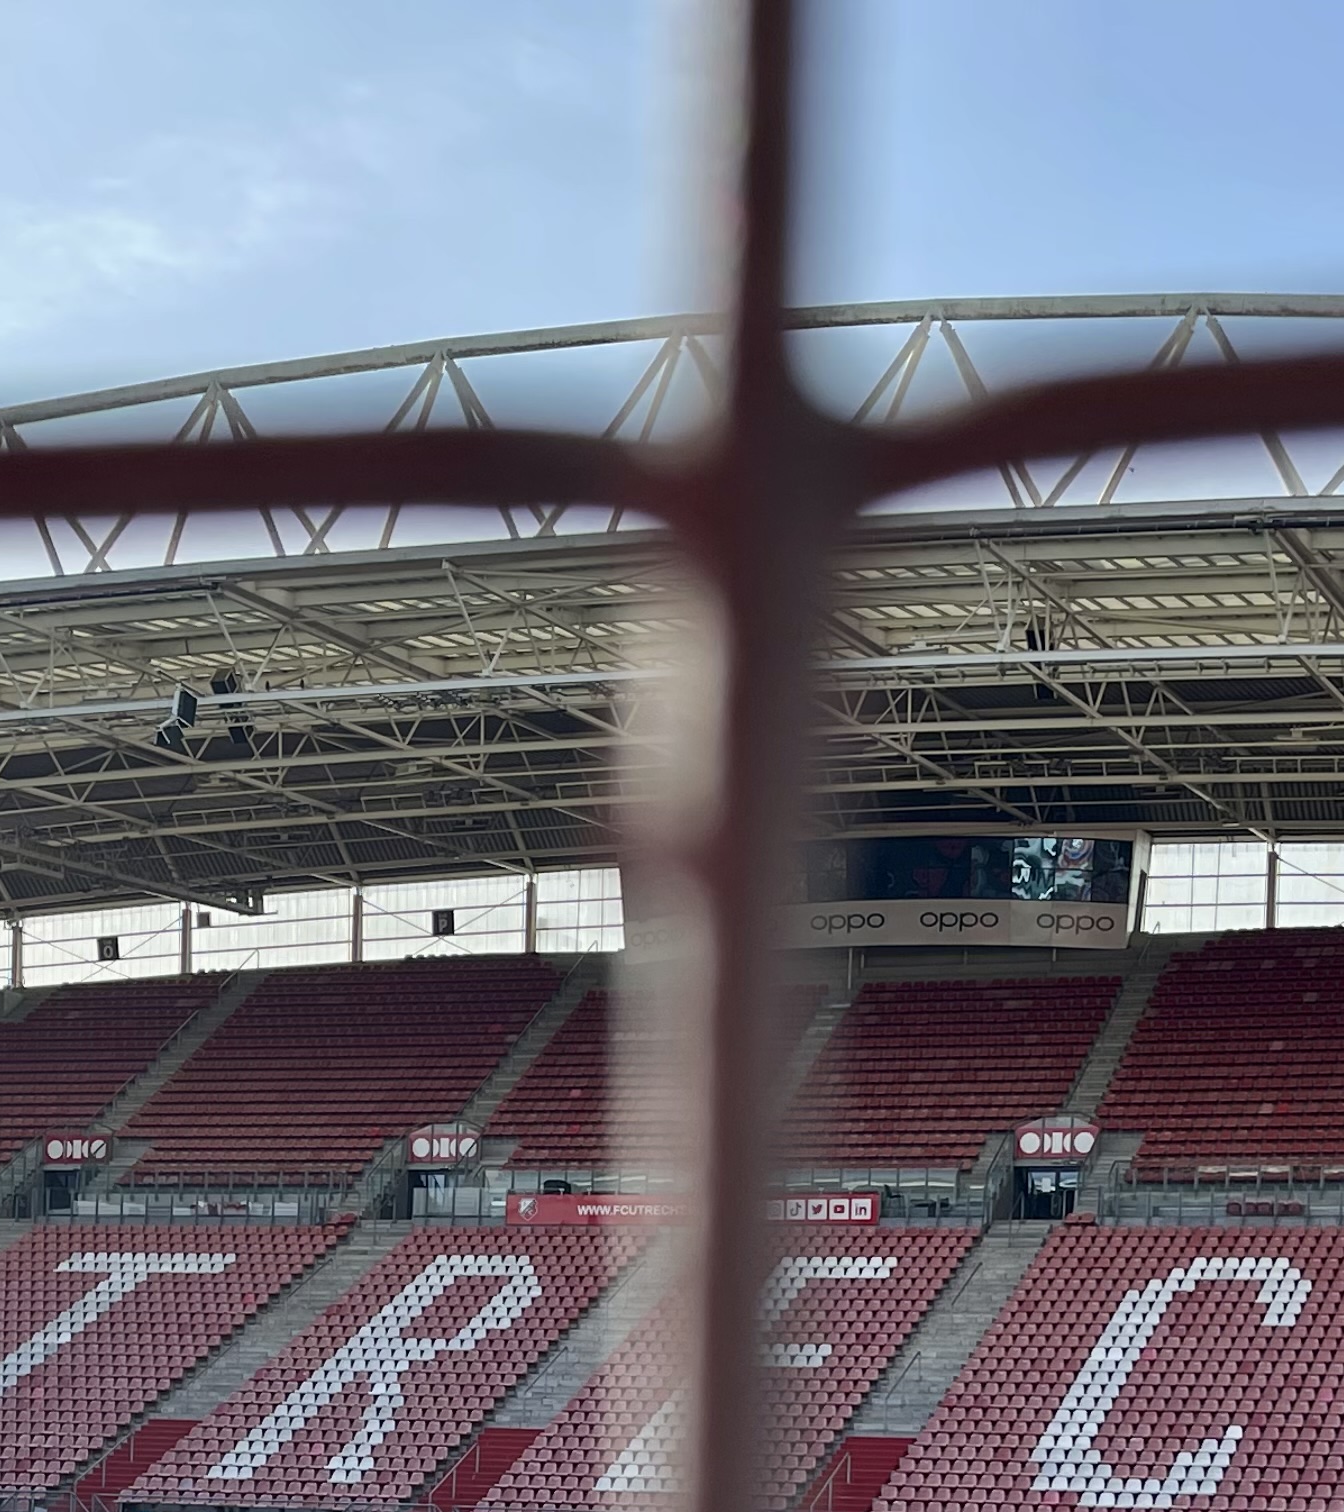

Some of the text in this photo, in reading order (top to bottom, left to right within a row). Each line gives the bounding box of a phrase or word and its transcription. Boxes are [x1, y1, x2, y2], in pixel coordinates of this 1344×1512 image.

[810, 912, 885, 935] oppo
[919, 911, 999, 932] oppo
[1036, 912, 1115, 936] oppo
